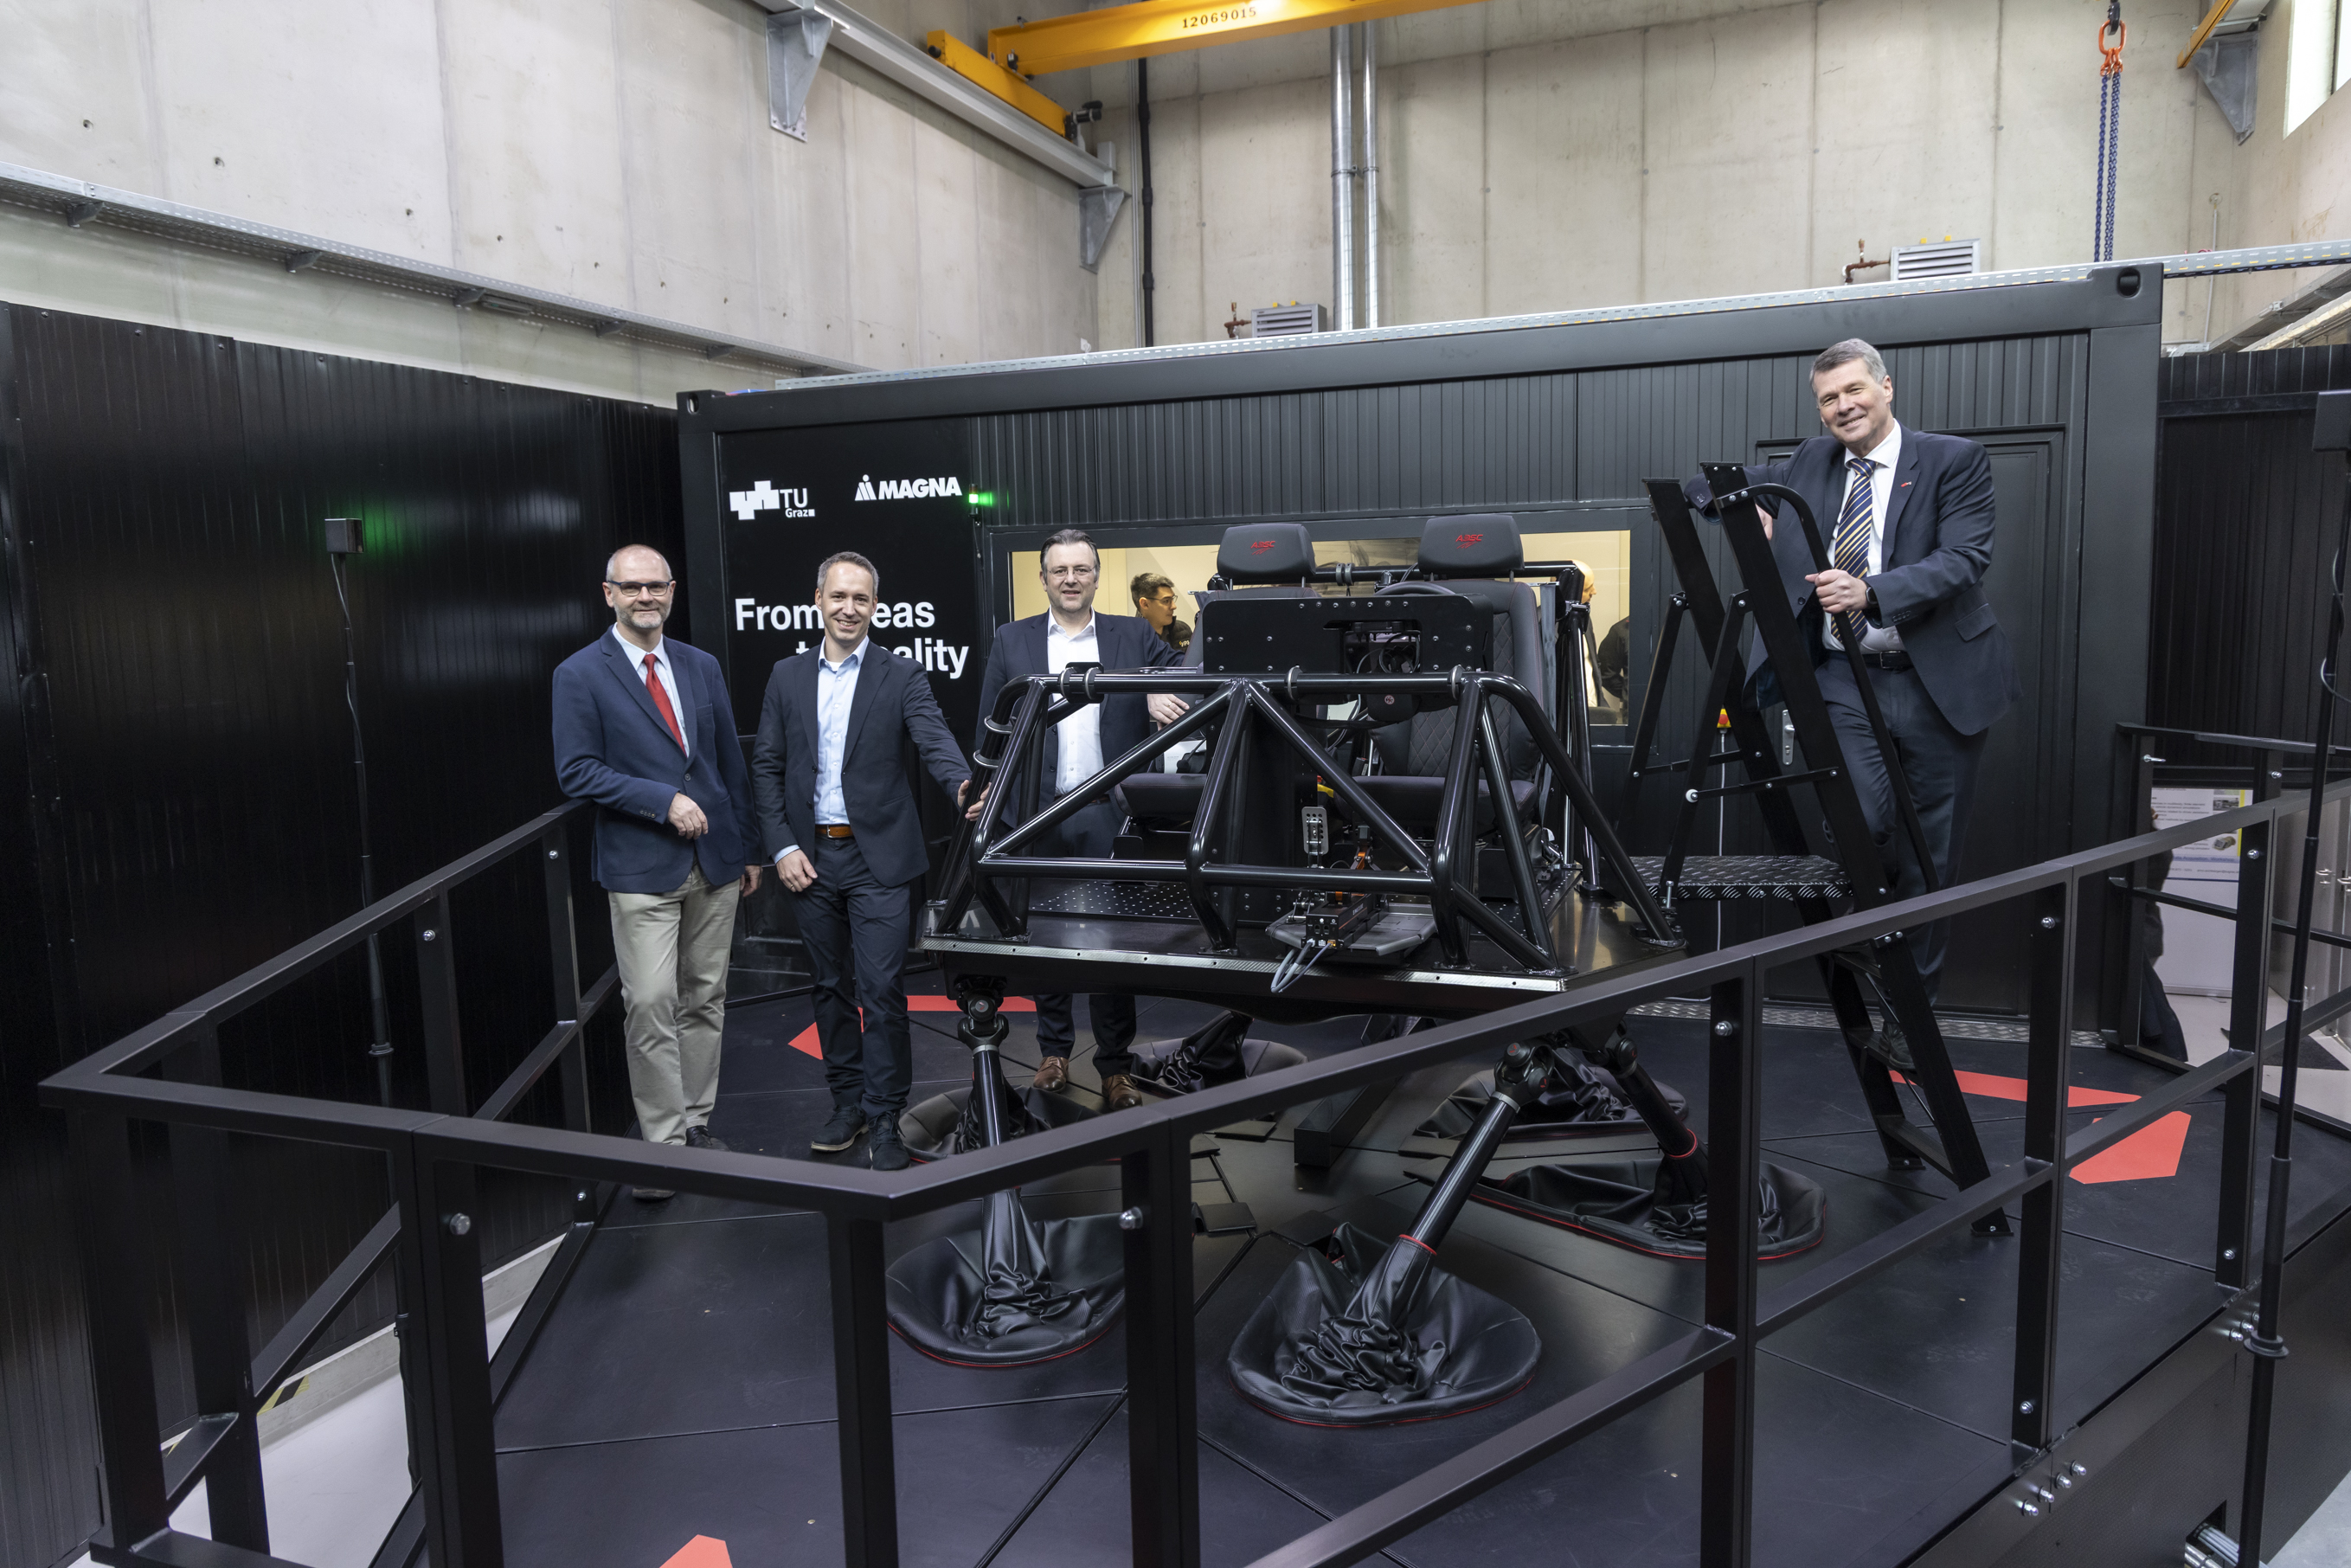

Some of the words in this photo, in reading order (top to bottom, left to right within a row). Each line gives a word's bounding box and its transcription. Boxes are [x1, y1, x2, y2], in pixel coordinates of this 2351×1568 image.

[1182, 6, 1256, 29] 12069015
[780, 487, 808, 509] TU
[878, 477, 963, 500] MAGNA
[785, 508, 808, 518] Graz
[735, 598, 824, 631] From
[870, 601, 935, 628] eas
